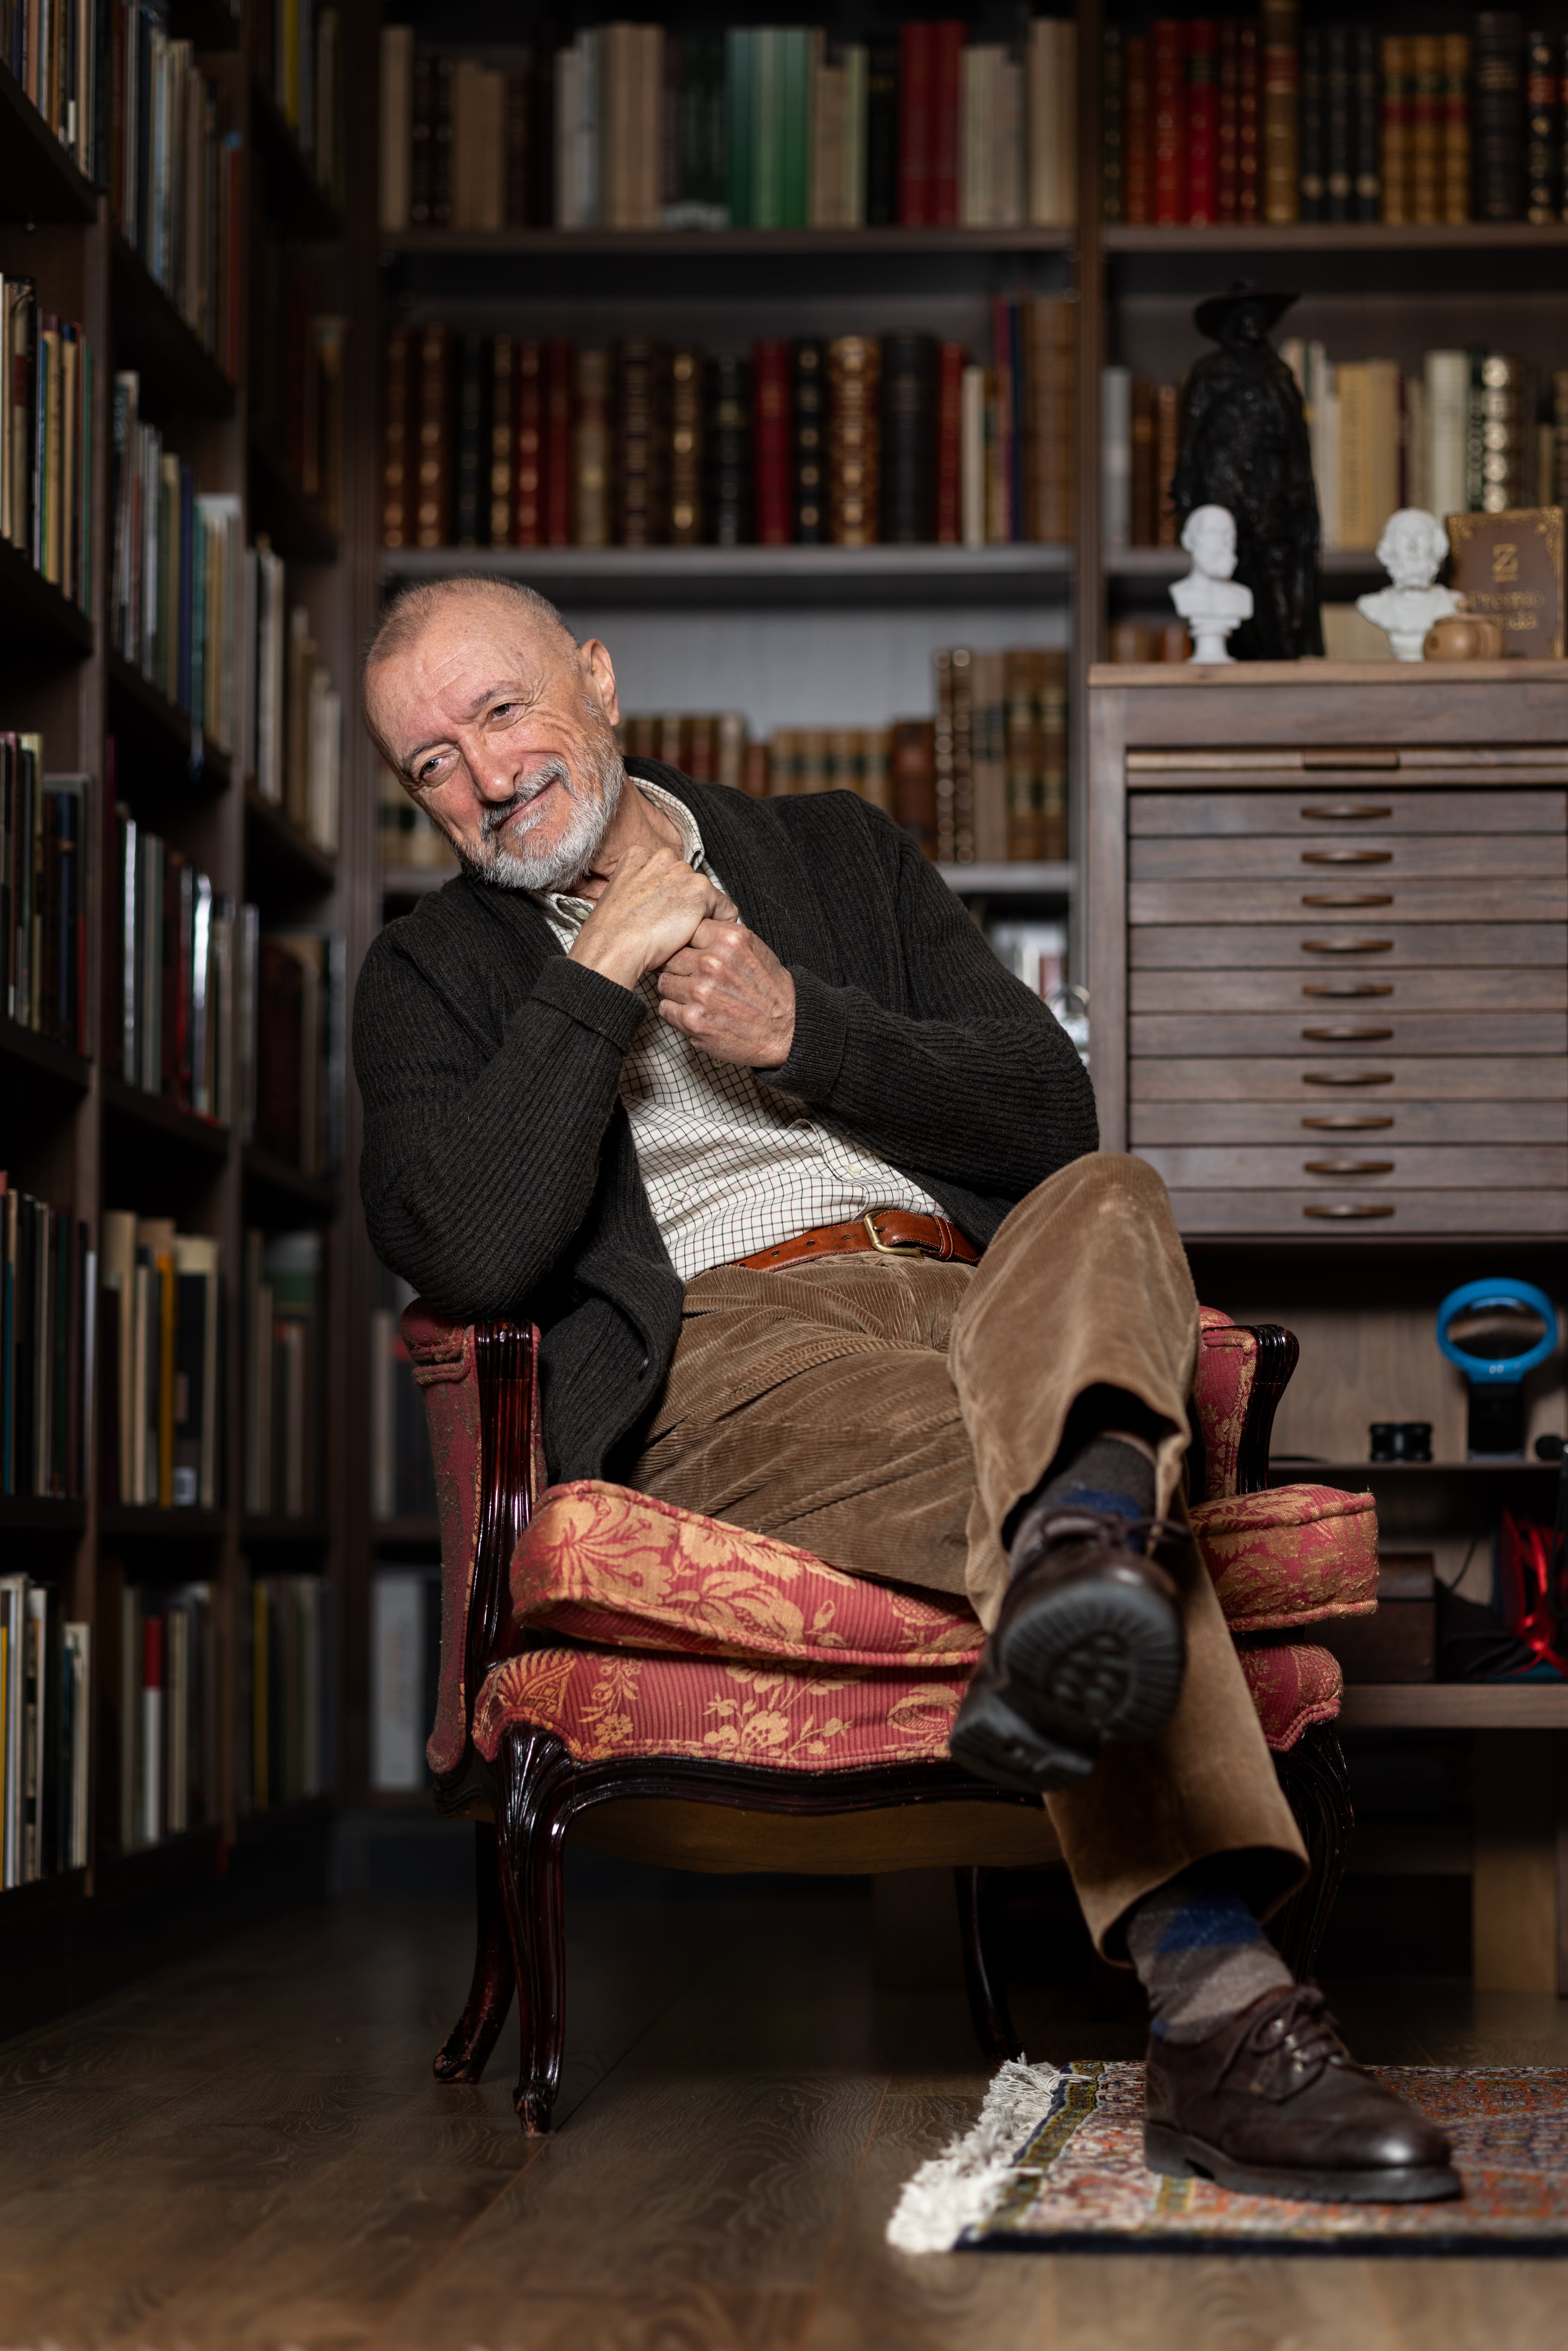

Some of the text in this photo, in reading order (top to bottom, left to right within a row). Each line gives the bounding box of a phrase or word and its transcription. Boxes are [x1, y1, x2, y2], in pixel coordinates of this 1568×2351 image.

[1492, 543, 1519, 574] Z
[1469, 590, 1545, 610] Premio
[1489, 610, 1537, 631] nda
